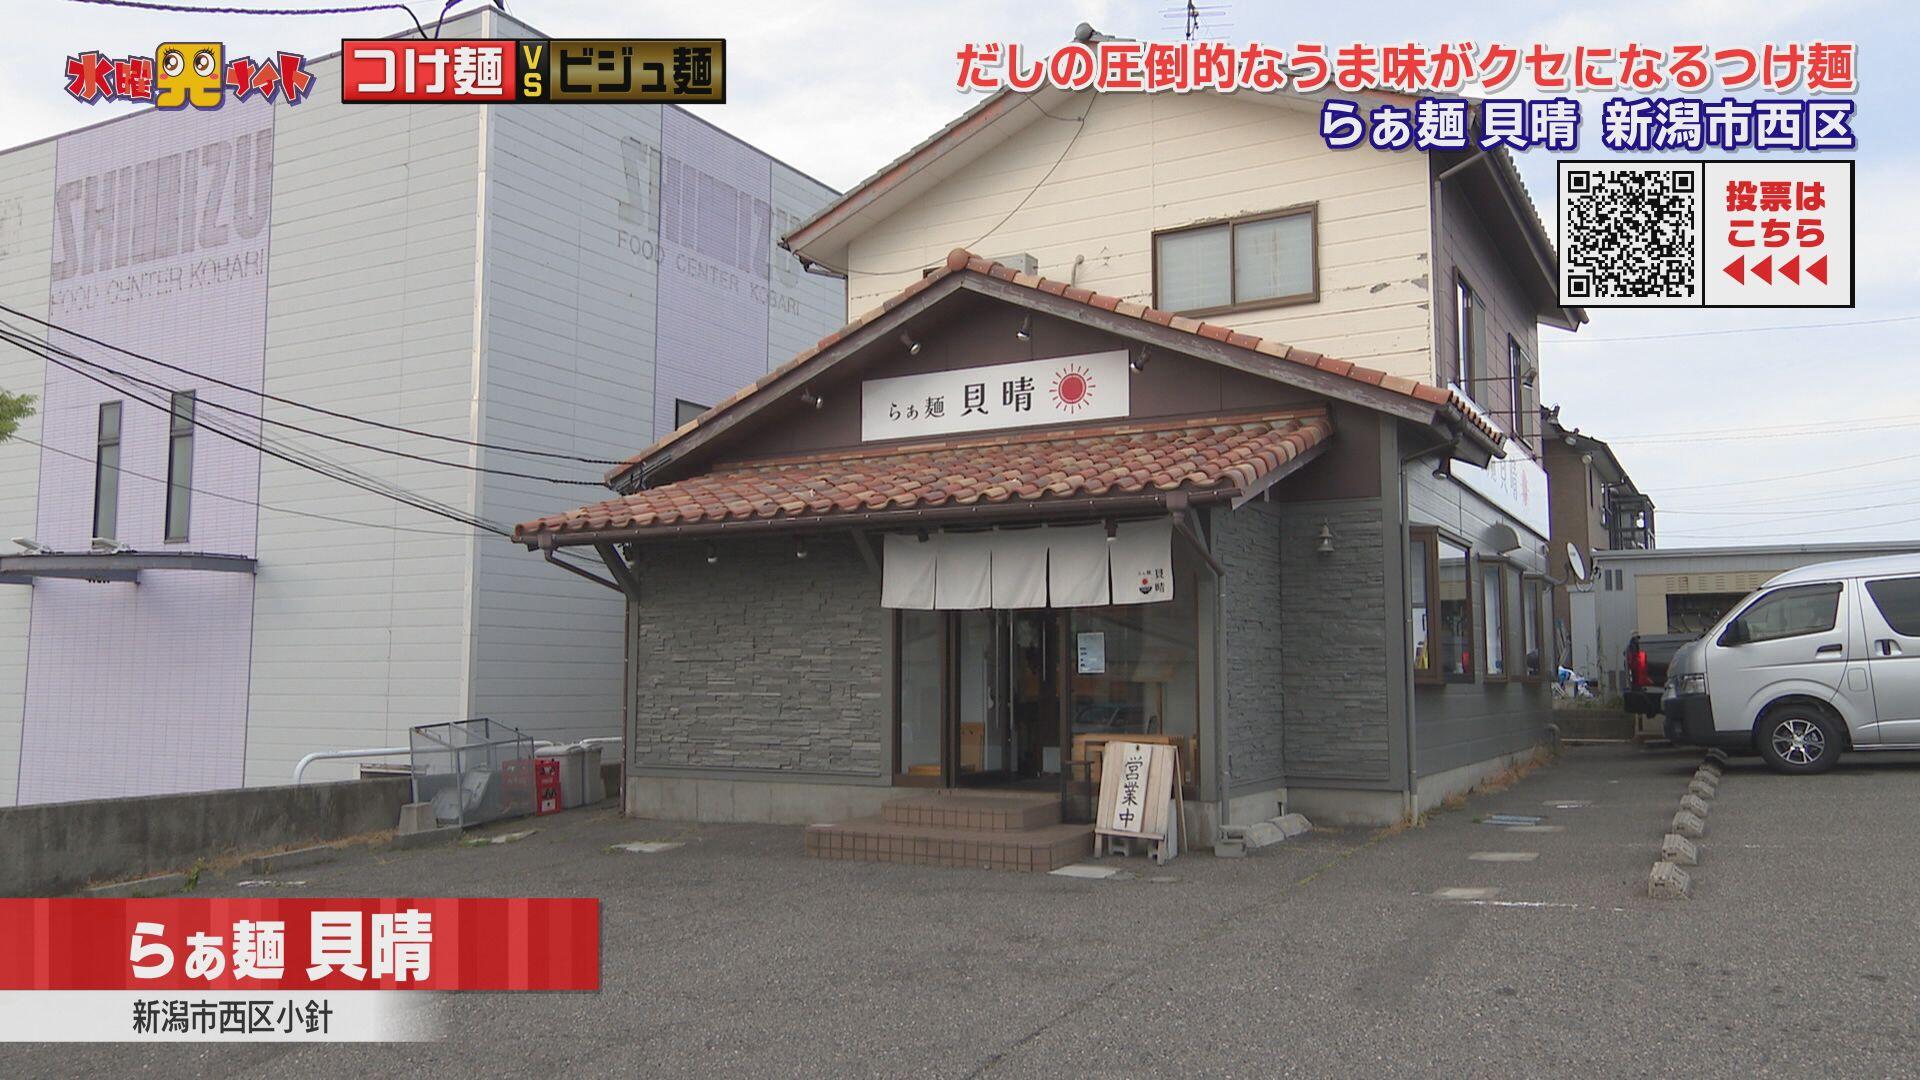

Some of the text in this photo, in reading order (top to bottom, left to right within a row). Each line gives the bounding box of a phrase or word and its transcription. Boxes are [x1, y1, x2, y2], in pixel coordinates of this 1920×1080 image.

[889, 376, 1035, 421] らぁ麺 貝晴
[1119, 756, 1144, 829] 営業中
